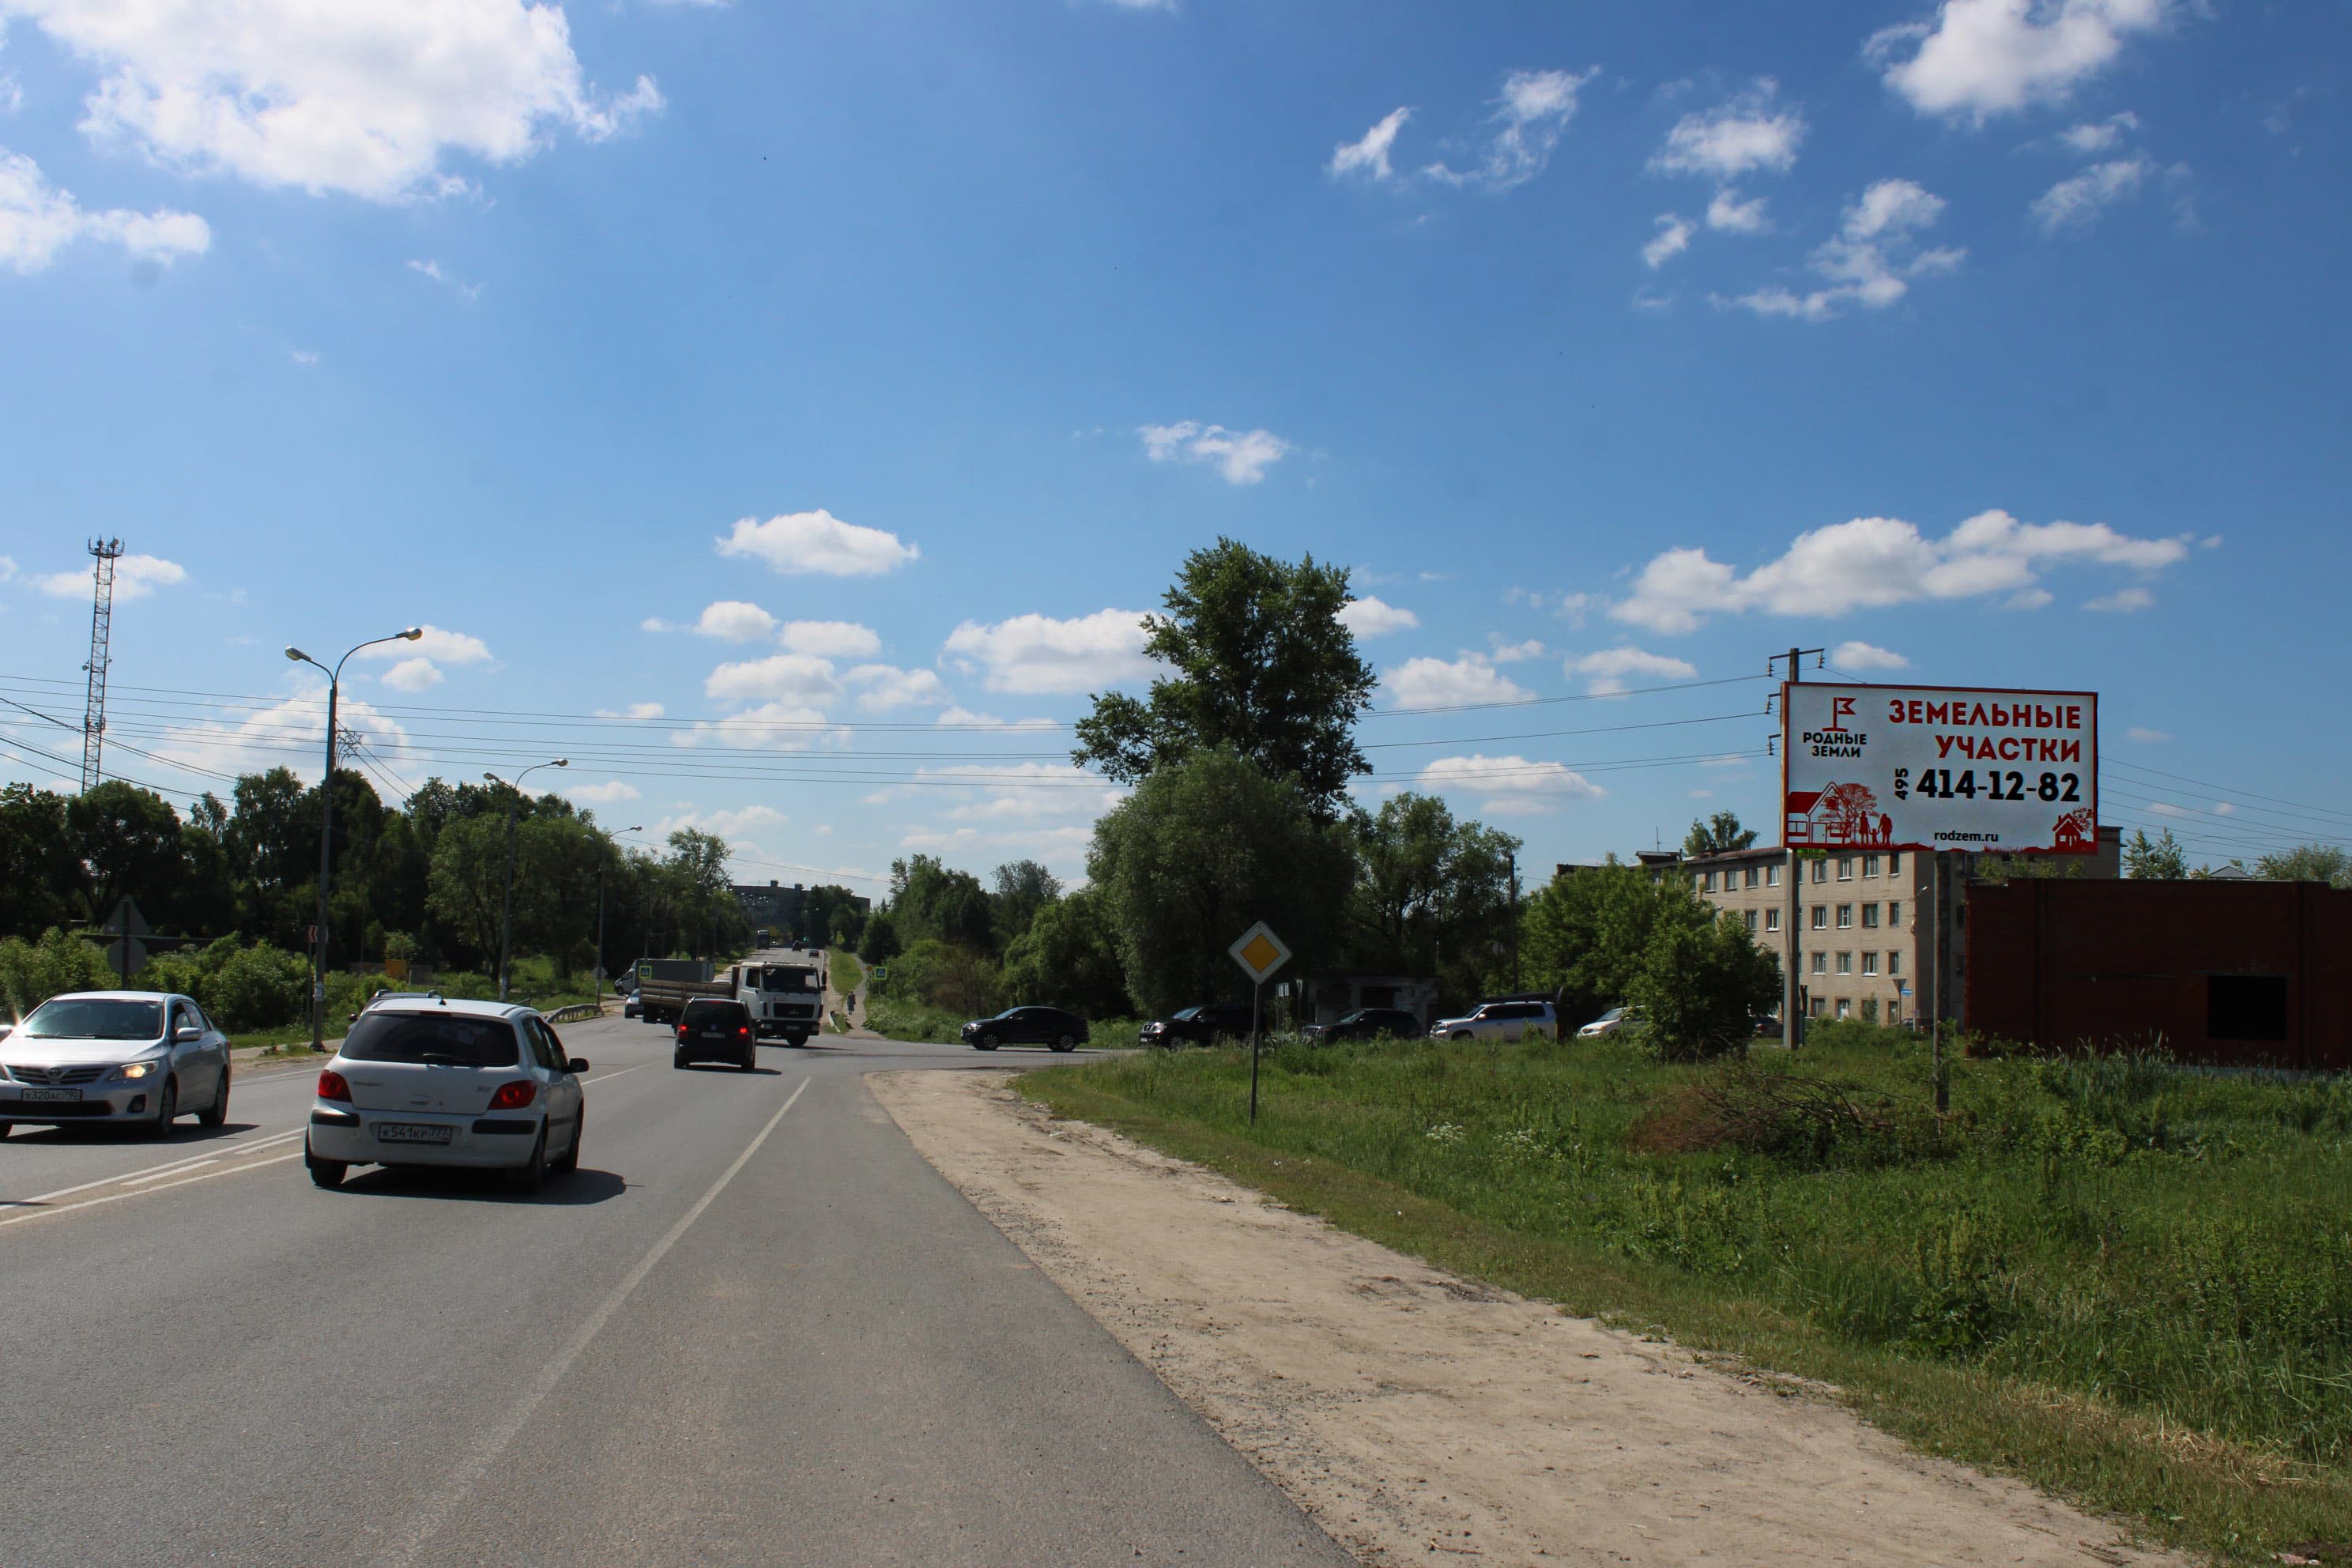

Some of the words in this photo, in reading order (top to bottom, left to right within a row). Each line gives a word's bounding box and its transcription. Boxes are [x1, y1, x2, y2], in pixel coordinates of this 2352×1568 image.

[1889, 699, 2081, 729] ЗЕМЕЛЬНЫЕ
[1803, 732, 1867, 745] РОДНЫЕ
[1811, 745, 1861, 758] ЗЕМЛИ
[1935, 735, 2080, 763] УЧАСТКИ
[1894, 767, 1909, 801] 495
[1917, 768, 2080, 802] 414-12-82
[1934, 830, 1999, 842] rodzem.ru
